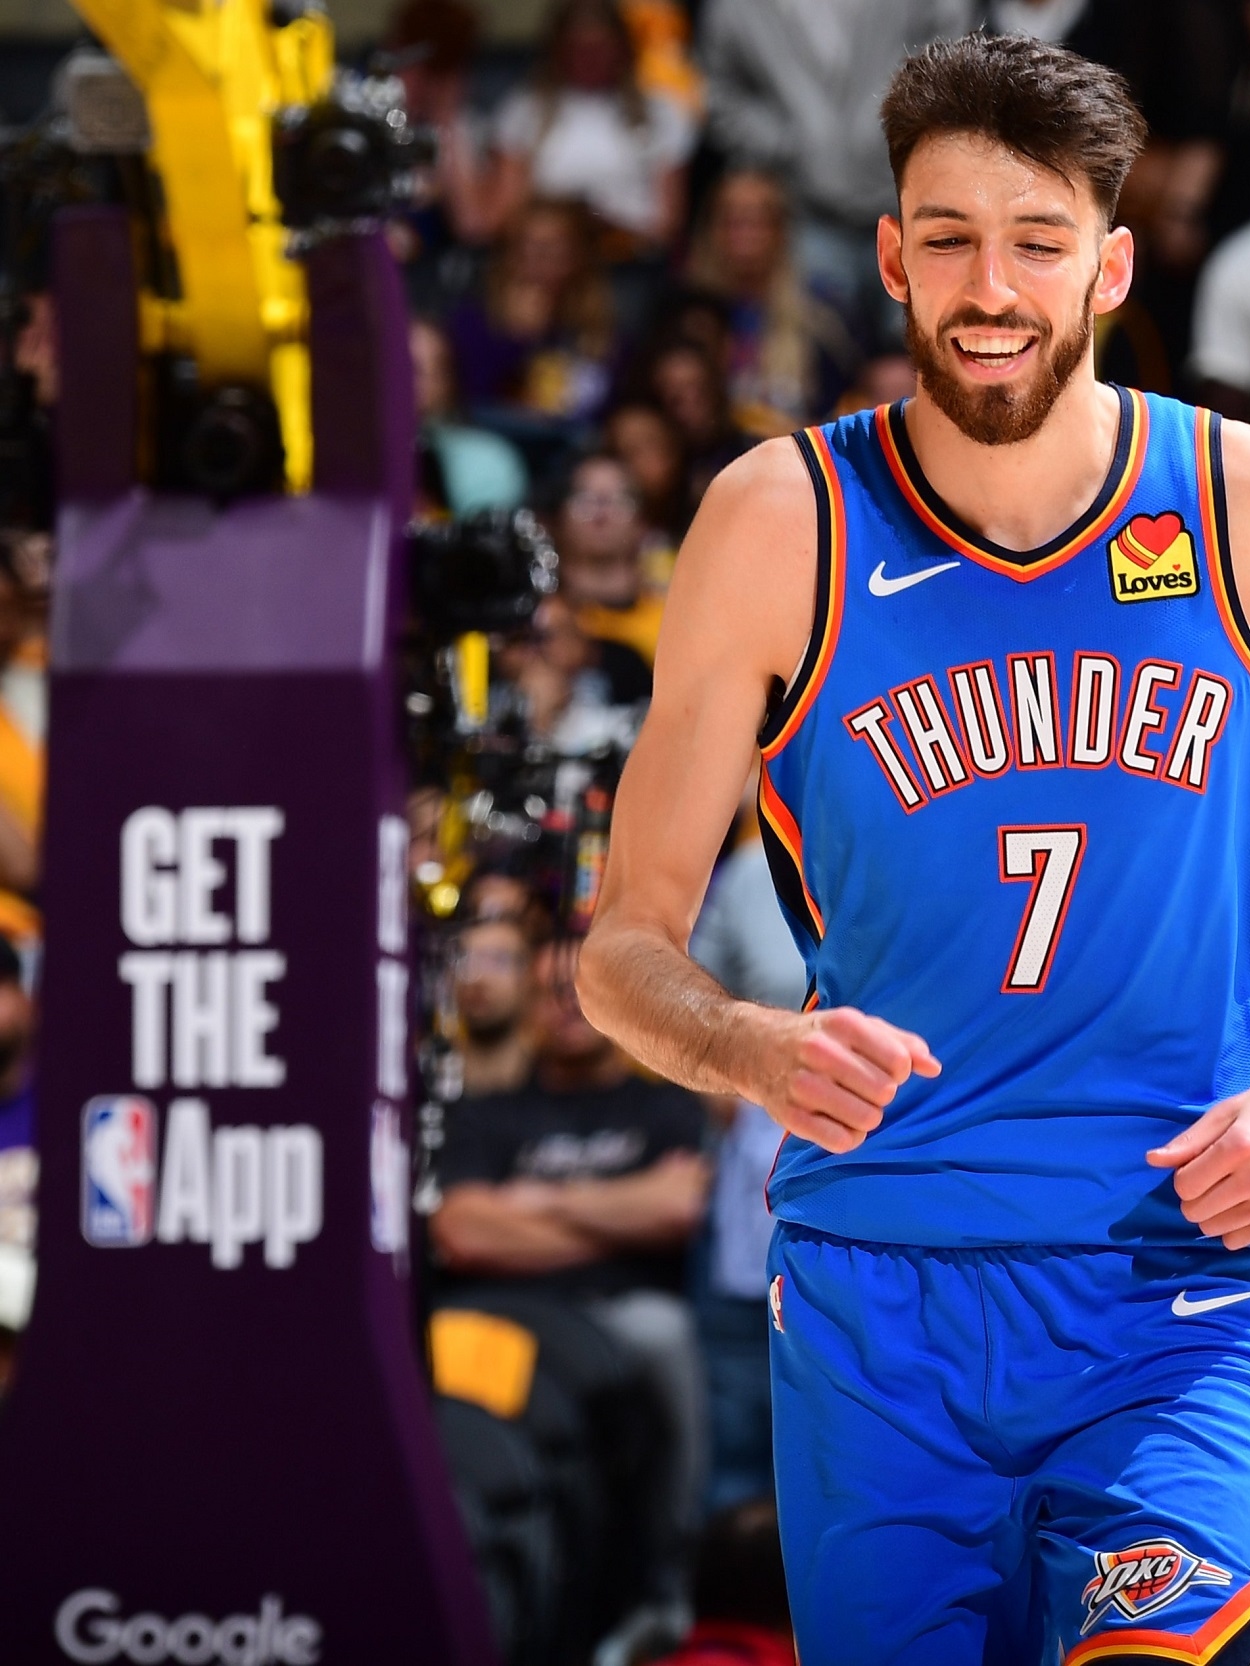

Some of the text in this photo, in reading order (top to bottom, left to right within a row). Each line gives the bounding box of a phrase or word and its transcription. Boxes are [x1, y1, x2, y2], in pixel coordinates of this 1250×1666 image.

[843, 651, 1232, 815] THUNDER
[120, 806, 284, 946] GET
[998, 824, 1087, 994] 7
[119, 952, 287, 1089] THE
[158, 1098, 324, 1269] App
[55, 1587, 323, 1666] Google
[1094, 1555, 1178, 1604] OKC
